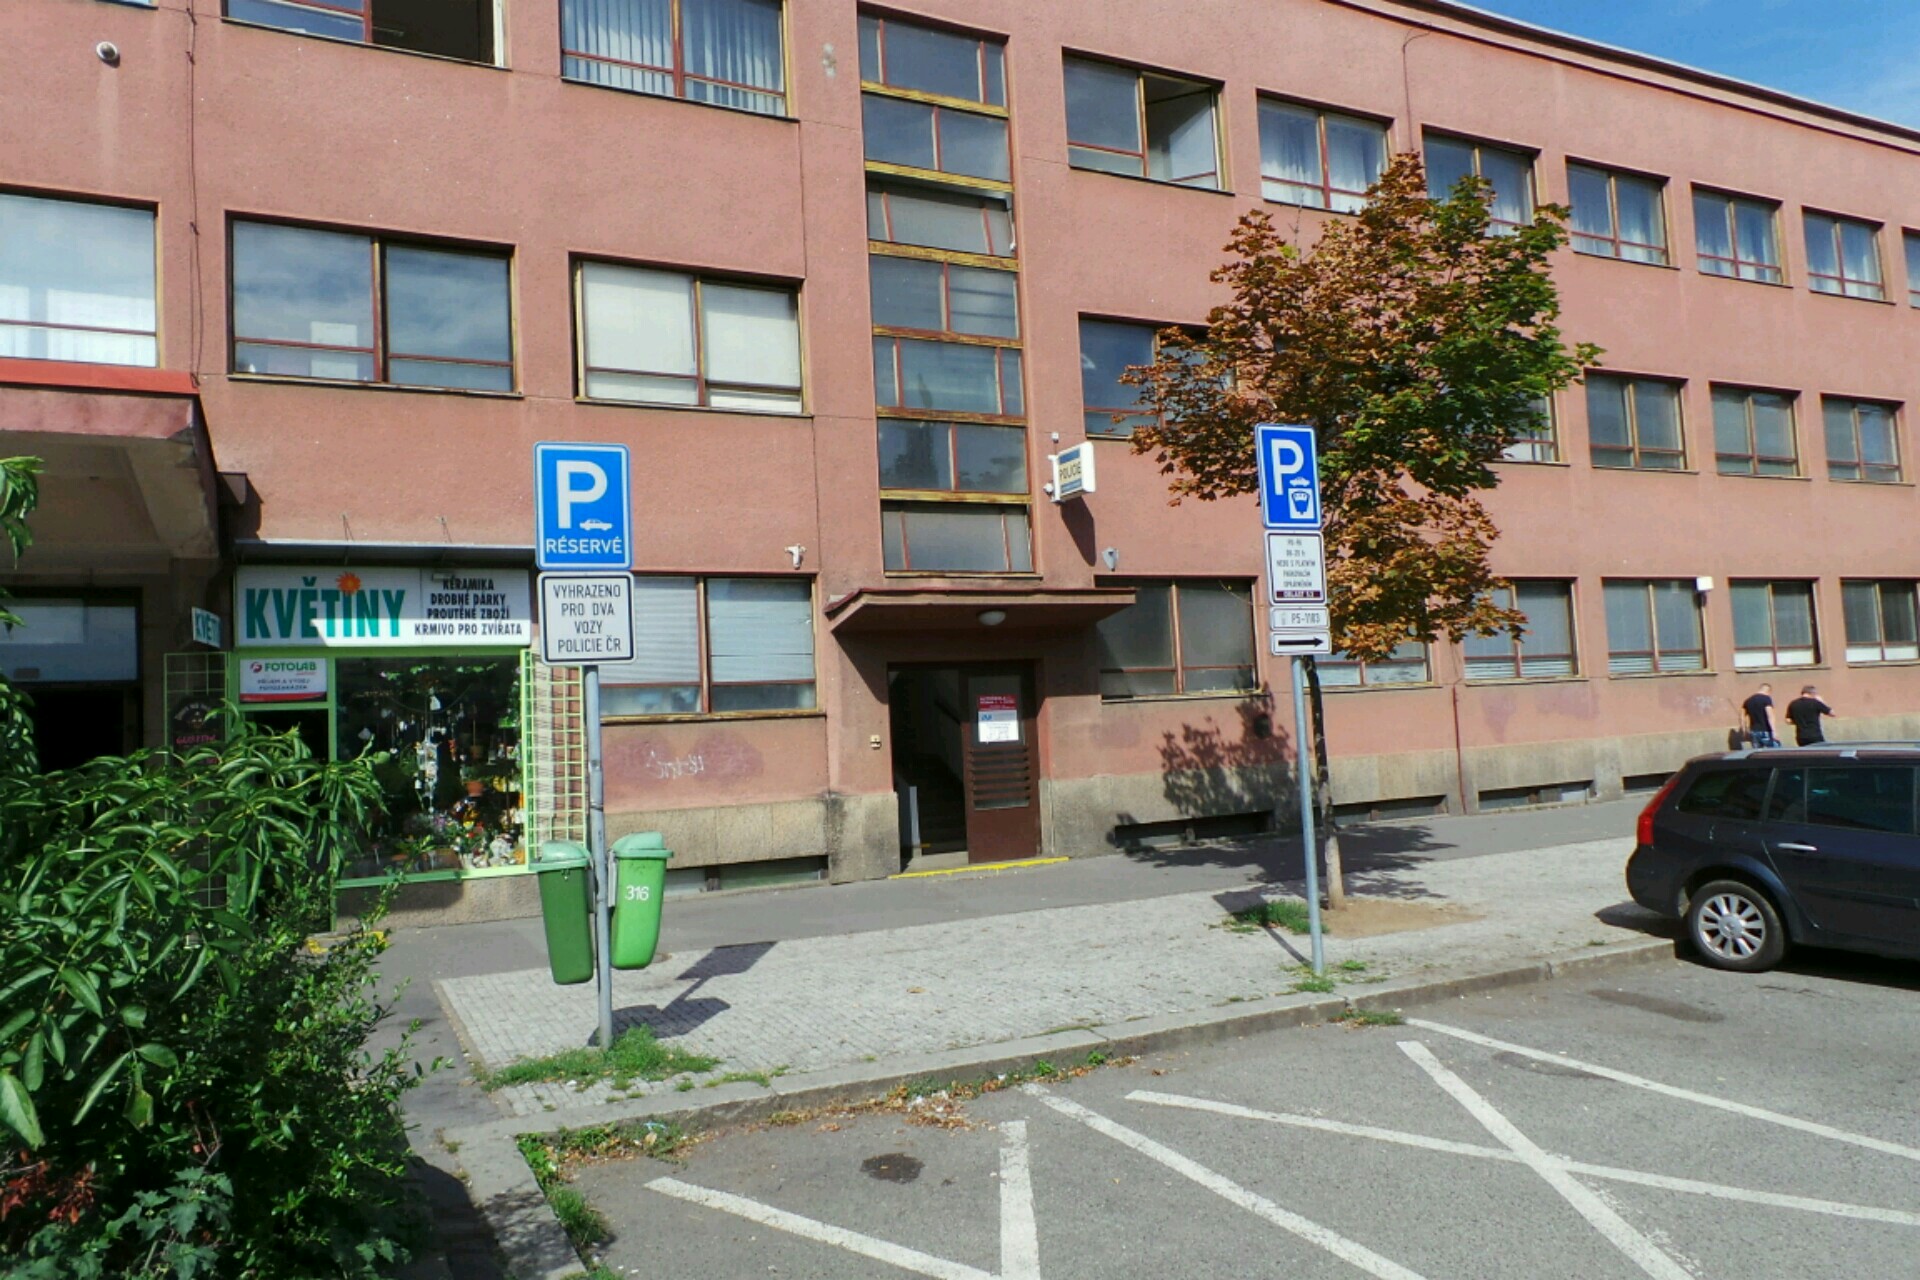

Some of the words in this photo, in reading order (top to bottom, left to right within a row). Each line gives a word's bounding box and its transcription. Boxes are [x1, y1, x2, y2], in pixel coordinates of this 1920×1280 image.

[1271, 438, 1304, 496] P
[556, 460, 608, 529] P
[546, 536, 623, 554] RÉSERVÉ
[431, 590, 469, 605] DROBNÉ
[473, 590, 506, 605] DÁRKY
[553, 585, 622, 598] VYHRAZENO
[246, 576, 406, 638] KVĚTINY
[481, 605, 510, 620] ZBOŽÍ
[561, 602, 585, 616] PRO
[593, 602, 615, 615] DVA
[414, 623, 454, 635] KRMIVO
[458, 623, 477, 635] PRO
[481, 621, 522, 635] ZVÍŘATA
[574, 620, 603, 634] VOZY
[558, 639, 602, 653] POLICIE
[606, 635, 621, 652] ČR
[264, 661, 317, 672] FOTOLAB
[624, 885, 650, 901] 316
